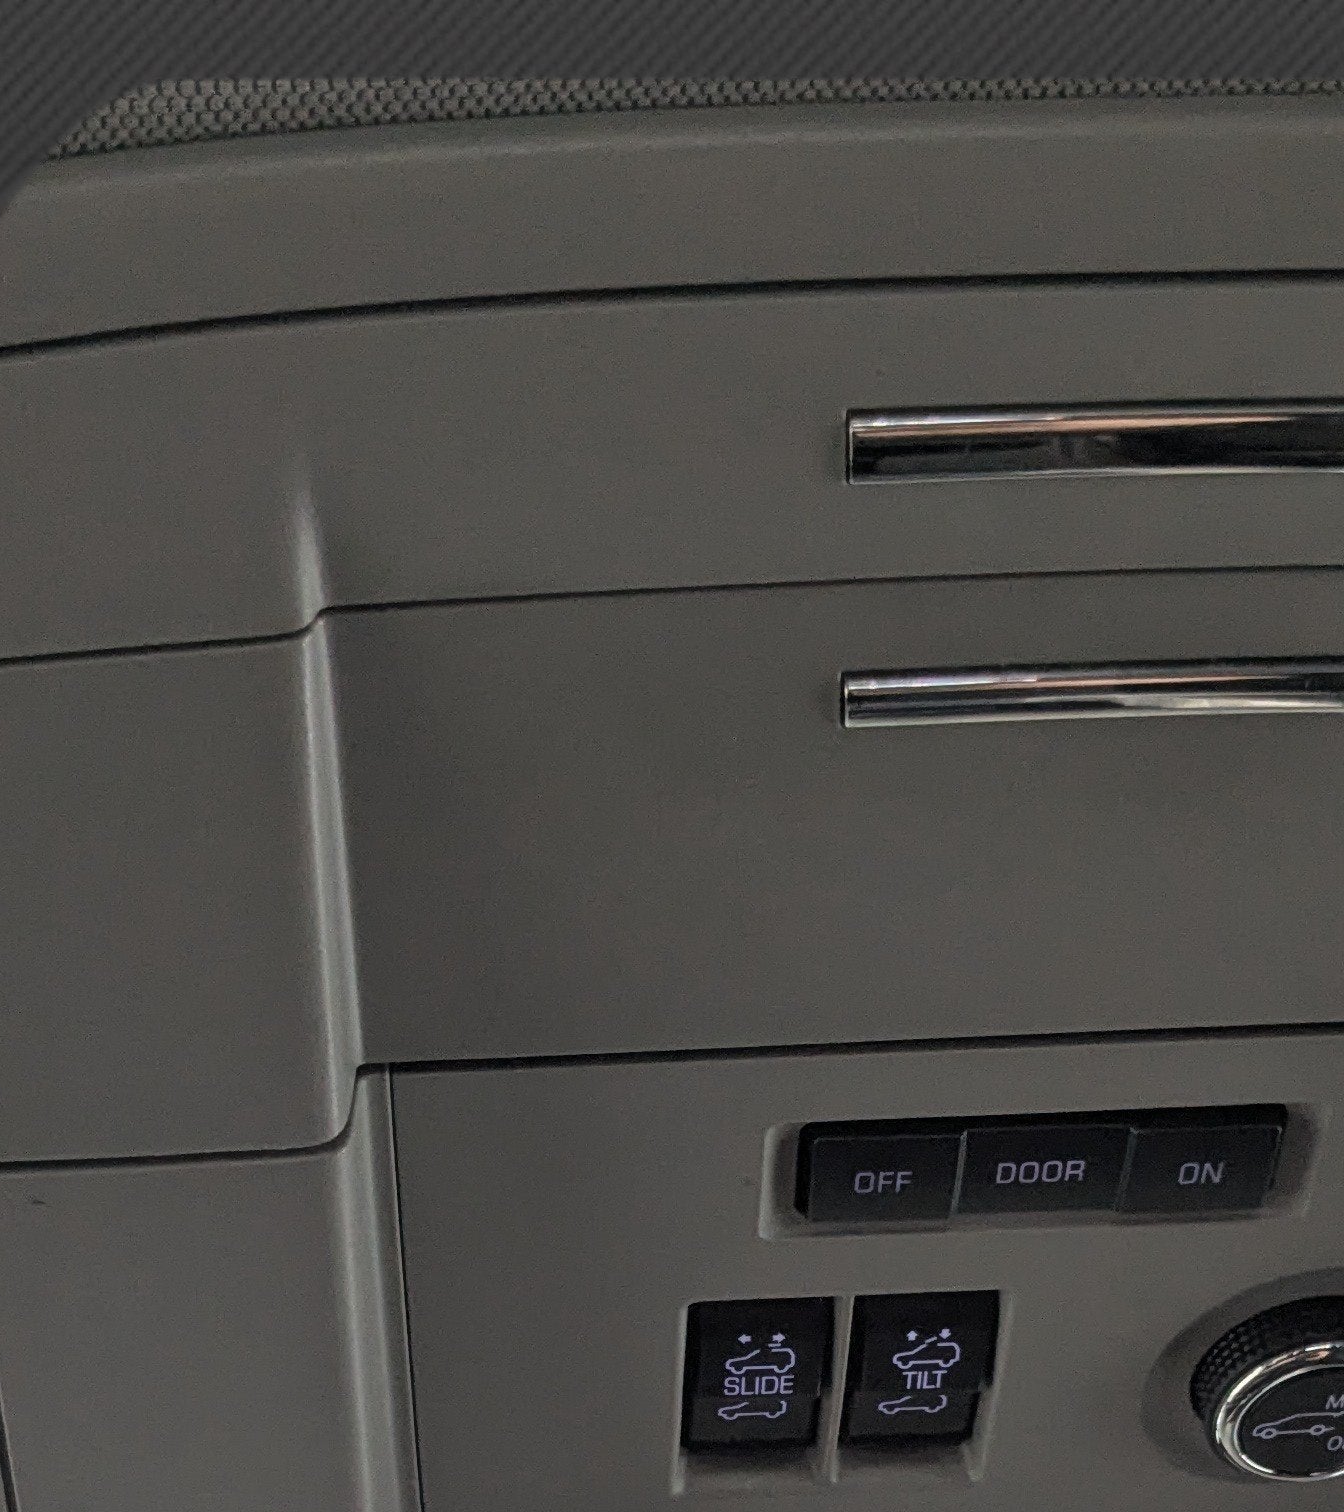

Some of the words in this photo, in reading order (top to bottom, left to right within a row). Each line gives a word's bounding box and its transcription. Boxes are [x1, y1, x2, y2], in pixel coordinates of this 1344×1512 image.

[854, 1170, 912, 1194] OFF
[995, 1159, 1086, 1185] DOOR
[1177, 1162, 1223, 1185] ON
[723, 1375, 794, 1397] SLIDE
[900, 1369, 949, 1391] TILT
